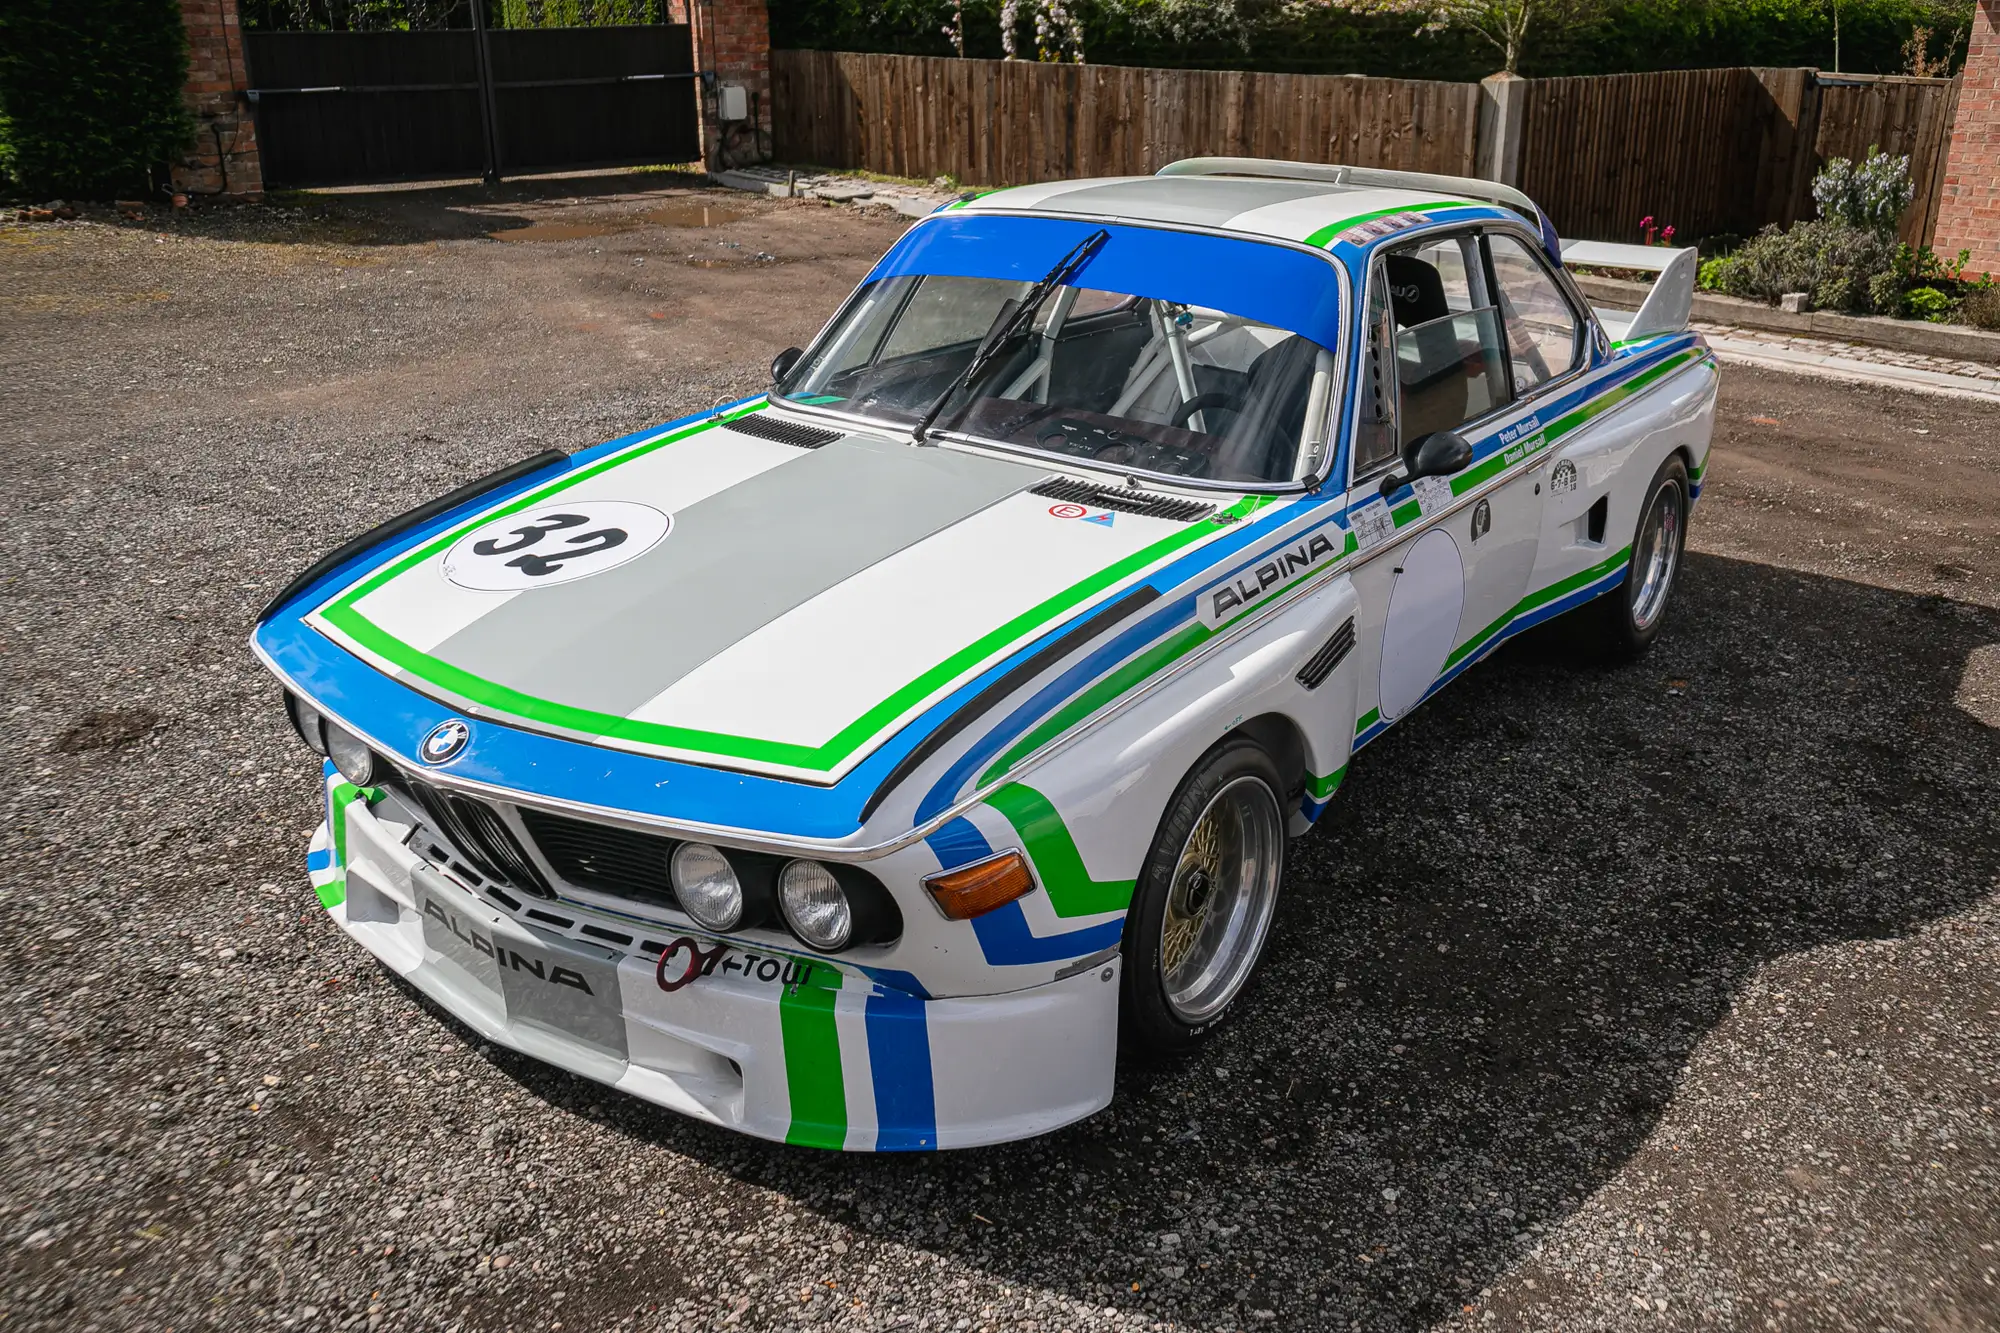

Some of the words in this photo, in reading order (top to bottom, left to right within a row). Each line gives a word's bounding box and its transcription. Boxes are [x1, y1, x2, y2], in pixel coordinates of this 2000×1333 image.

[1499, 429, 1518, 445] Peter
[1516, 415, 1541, 436] Mursall
[1503, 445, 1524, 465] Daniel
[1523, 433, 1546, 454] Mursall
[1056, 506, 1080, 516] E
[473, 513, 629, 577] 32
[1212, 532, 1335, 620] ALPINA
[424, 897, 596, 997] ALPINA
[743, 953, 813, 986] TOW
